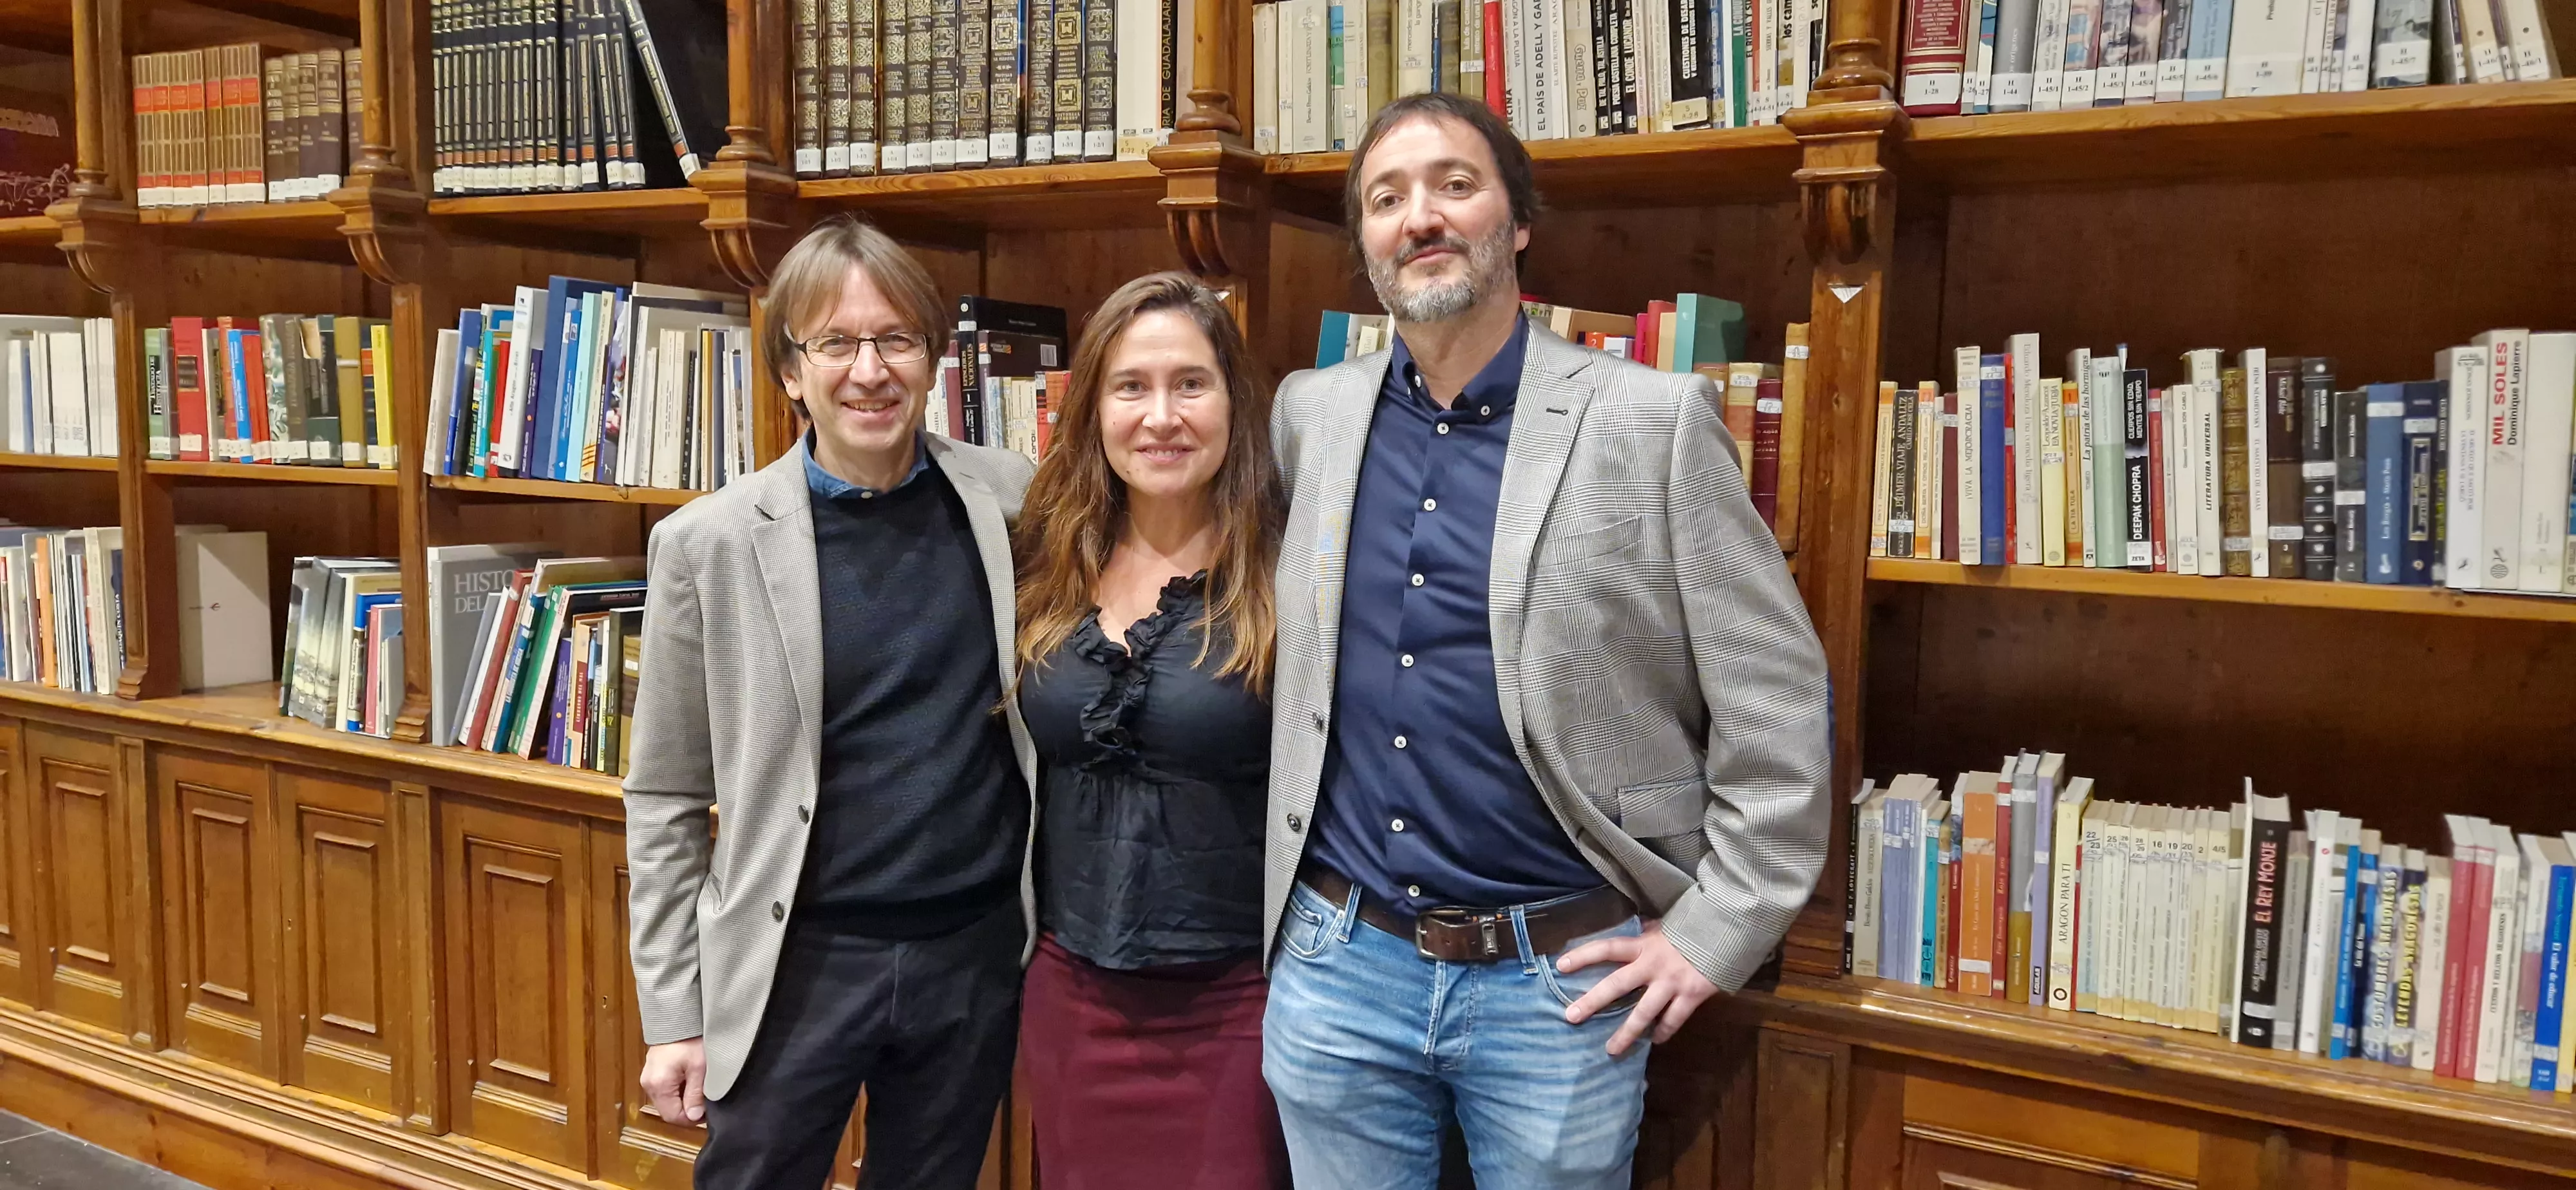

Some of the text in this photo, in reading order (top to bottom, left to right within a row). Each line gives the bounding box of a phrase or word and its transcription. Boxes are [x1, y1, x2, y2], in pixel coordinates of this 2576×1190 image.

[1513, 28, 1520, 39] LA
[1681, 24, 1689, 34] DE
[1732, 26, 1744, 36] LA
[1783, 23, 1792, 39] los
[1535, 33, 1544, 68] ADELL
[1623, 18, 1636, 93] EL CONDE LUCANOR
[1681, 36, 1690, 79] CUESTIONES
[1536, 72, 1544, 87] DE
[1162, 86, 1171, 100] DE
[1535, 90, 1545, 115] PAÍS
[1162, 108, 1171, 129] RIA
[1538, 117, 1546, 131] EL
[967, 343, 975, 386] NACIONALES
[2023, 379, 2032, 415] Mendoza
[2492, 343, 2508, 444] MIL SOLES
[2506, 340, 2522, 446] Dominique Lapierre
[2080, 355, 2092, 461] La patria de las hormigas
[1895, 395, 1907, 507] PRIMER VIAJE ANDALUZ
[1965, 466, 1973, 475] LA
[2204, 461, 2213, 510] LITERATURA
[2132, 465, 2143, 540] DEEPAK CHOPRA
[453, 569, 514, 595] HISTO
[455, 595, 485, 614] DEL
[2060, 874, 2070, 900] PARA
[2254, 841, 2277, 922] EL REY MONJE
[2058, 903, 2070, 944] ARAGON
[2372, 871, 2397, 1028] COSTUMBRES ARAGONESAS
[2396, 885, 2421, 1028] LEYENDAS ARAGONESAS
[2550, 953, 2561, 970] valor
[2549, 972, 2558, 981] de
[2546, 983, 2556, 1008] educar
